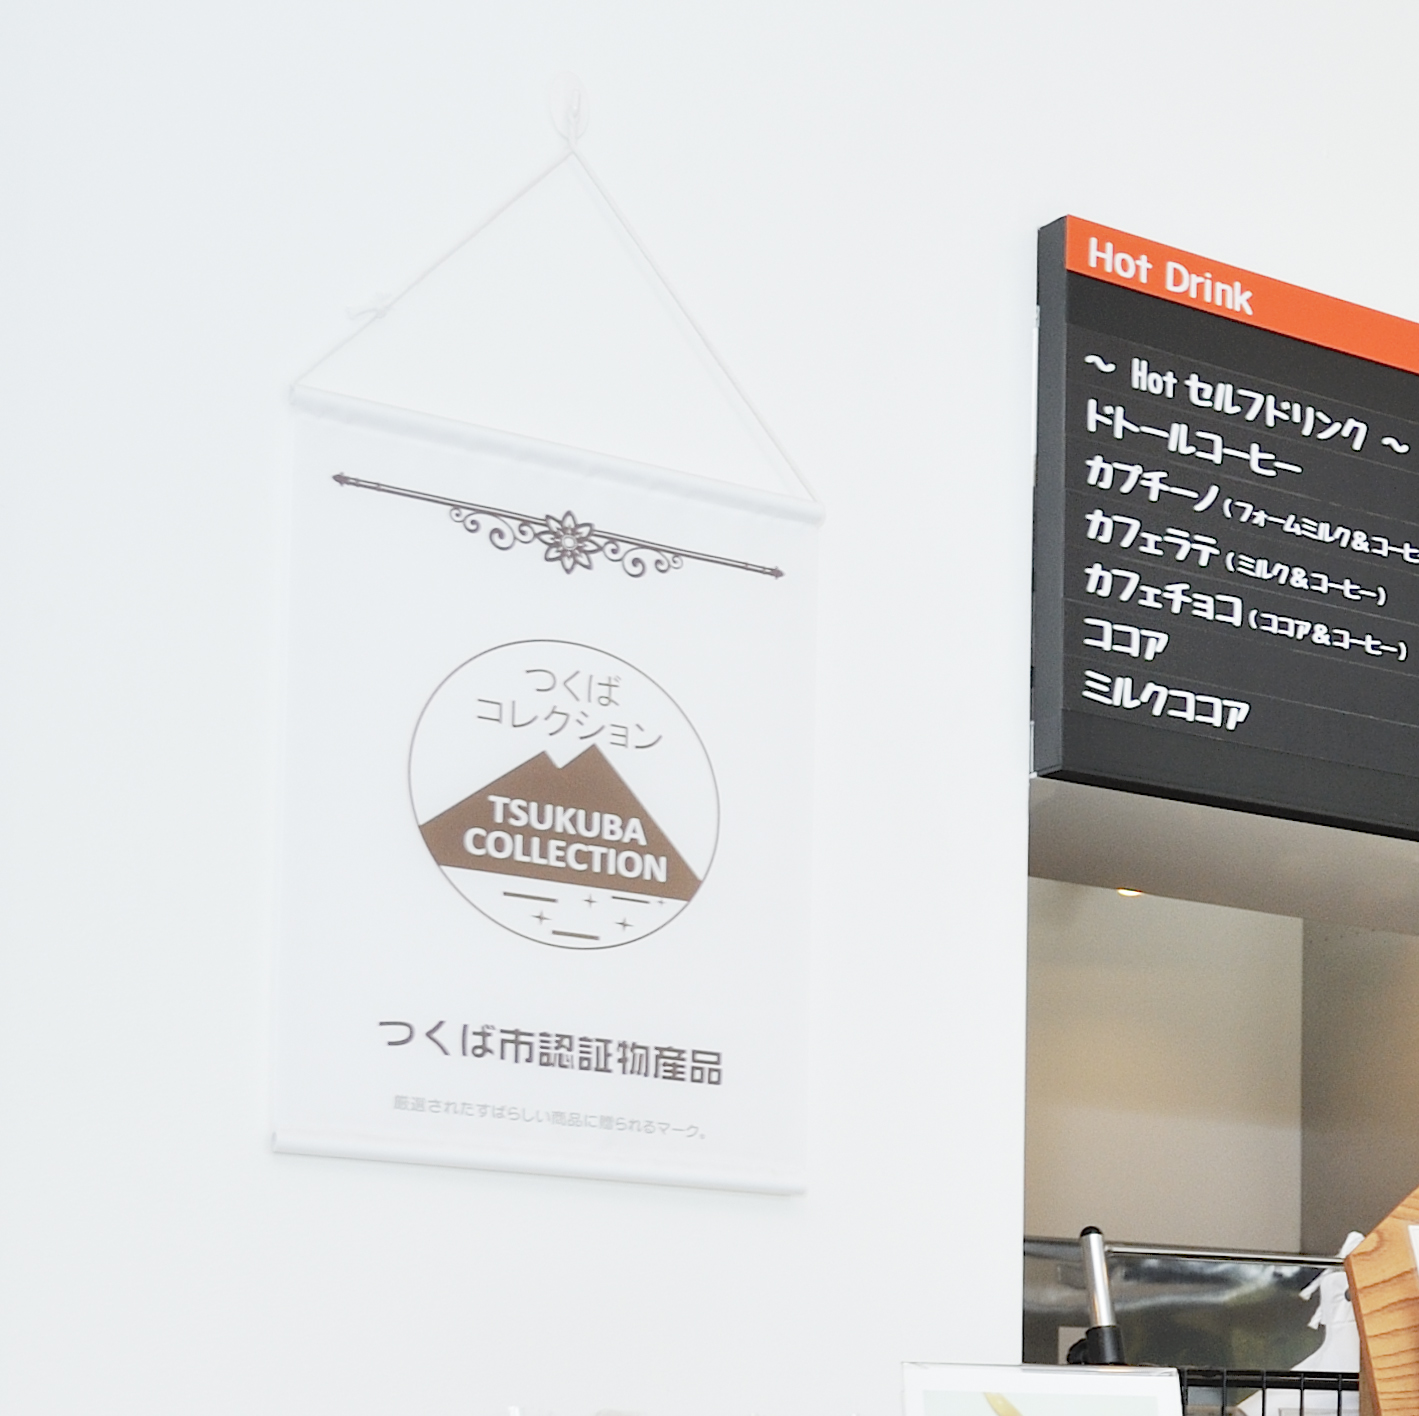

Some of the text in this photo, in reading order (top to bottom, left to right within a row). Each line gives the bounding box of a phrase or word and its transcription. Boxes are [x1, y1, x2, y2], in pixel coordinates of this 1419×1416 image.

[1088, 238, 1254, 316] Hot Drink
[1131, 358, 1177, 399] Hot
[1185, 373, 1369, 453] セルフドリンク
[1085, 397, 1303, 478] ドトールコーヒー
[1085, 454, 1218, 512] カプチーノ
[1085, 508, 1220, 566] カフェラテ
[1084, 562, 1243, 628] カフェチョコ
[1083, 616, 1170, 662] ココア
[525, 663, 620, 707] つくば
[1082, 668, 1250, 731] ミルクココア
[475, 695, 663, 752] コレクション
[488, 794, 648, 848] TSUKUBA
[462, 826, 668, 884] COLLECTION
[377, 1017, 724, 1087] つくば市認証物産品
